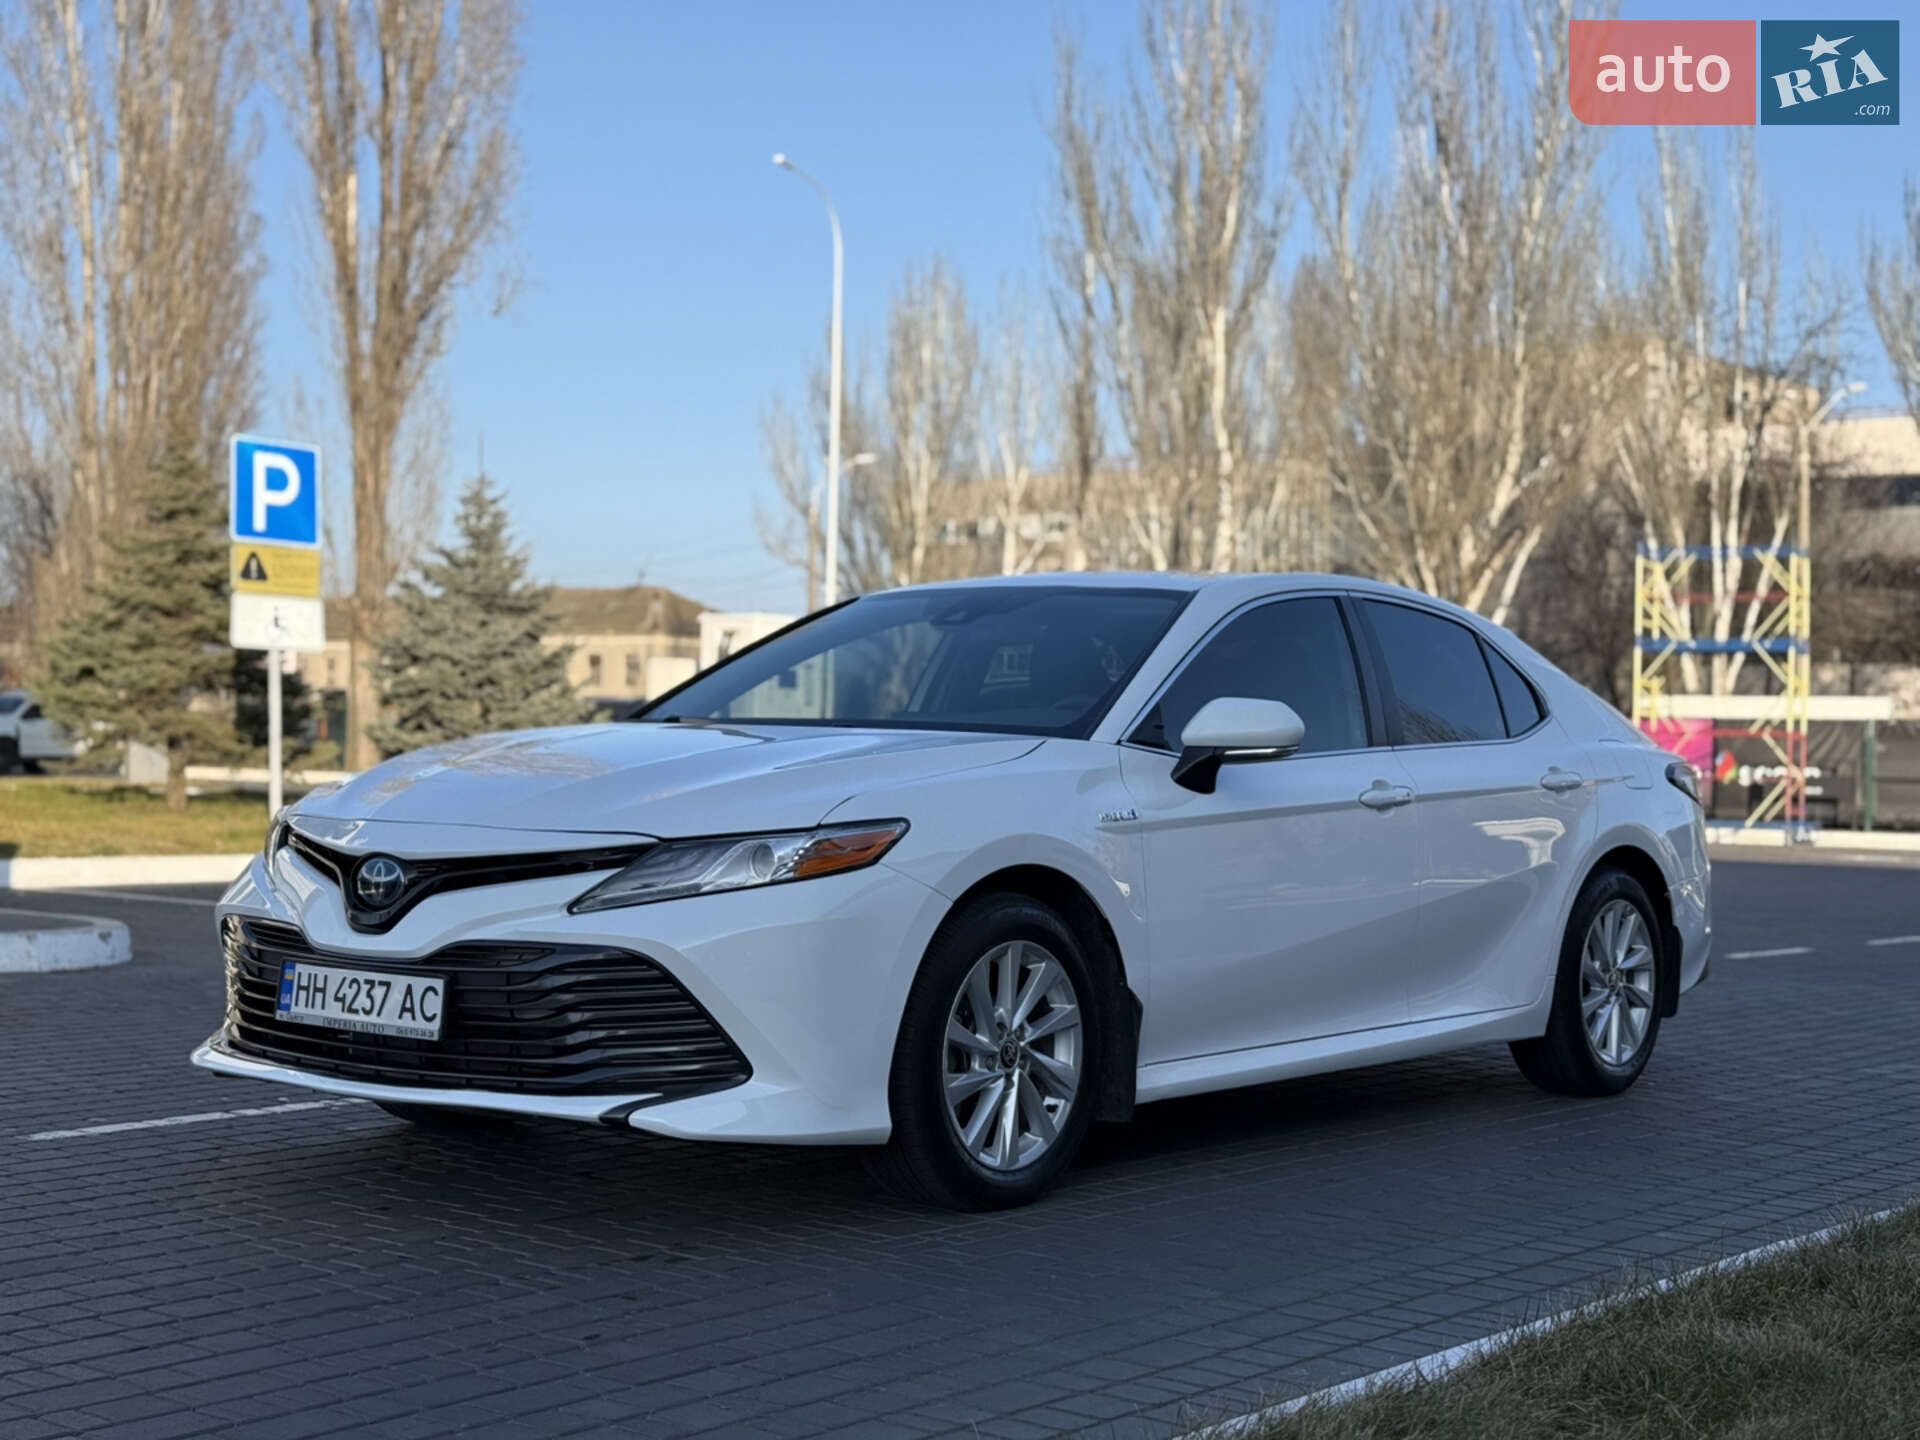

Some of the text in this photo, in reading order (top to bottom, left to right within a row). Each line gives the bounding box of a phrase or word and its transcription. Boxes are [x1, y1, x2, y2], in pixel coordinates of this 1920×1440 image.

[252, 449, 301, 534] P
[294, 971, 440, 1023] HH 4237 AC
[322, 1017, 357, 1031] IMPERIA
[359, 1021, 385, 1034] AUTO
